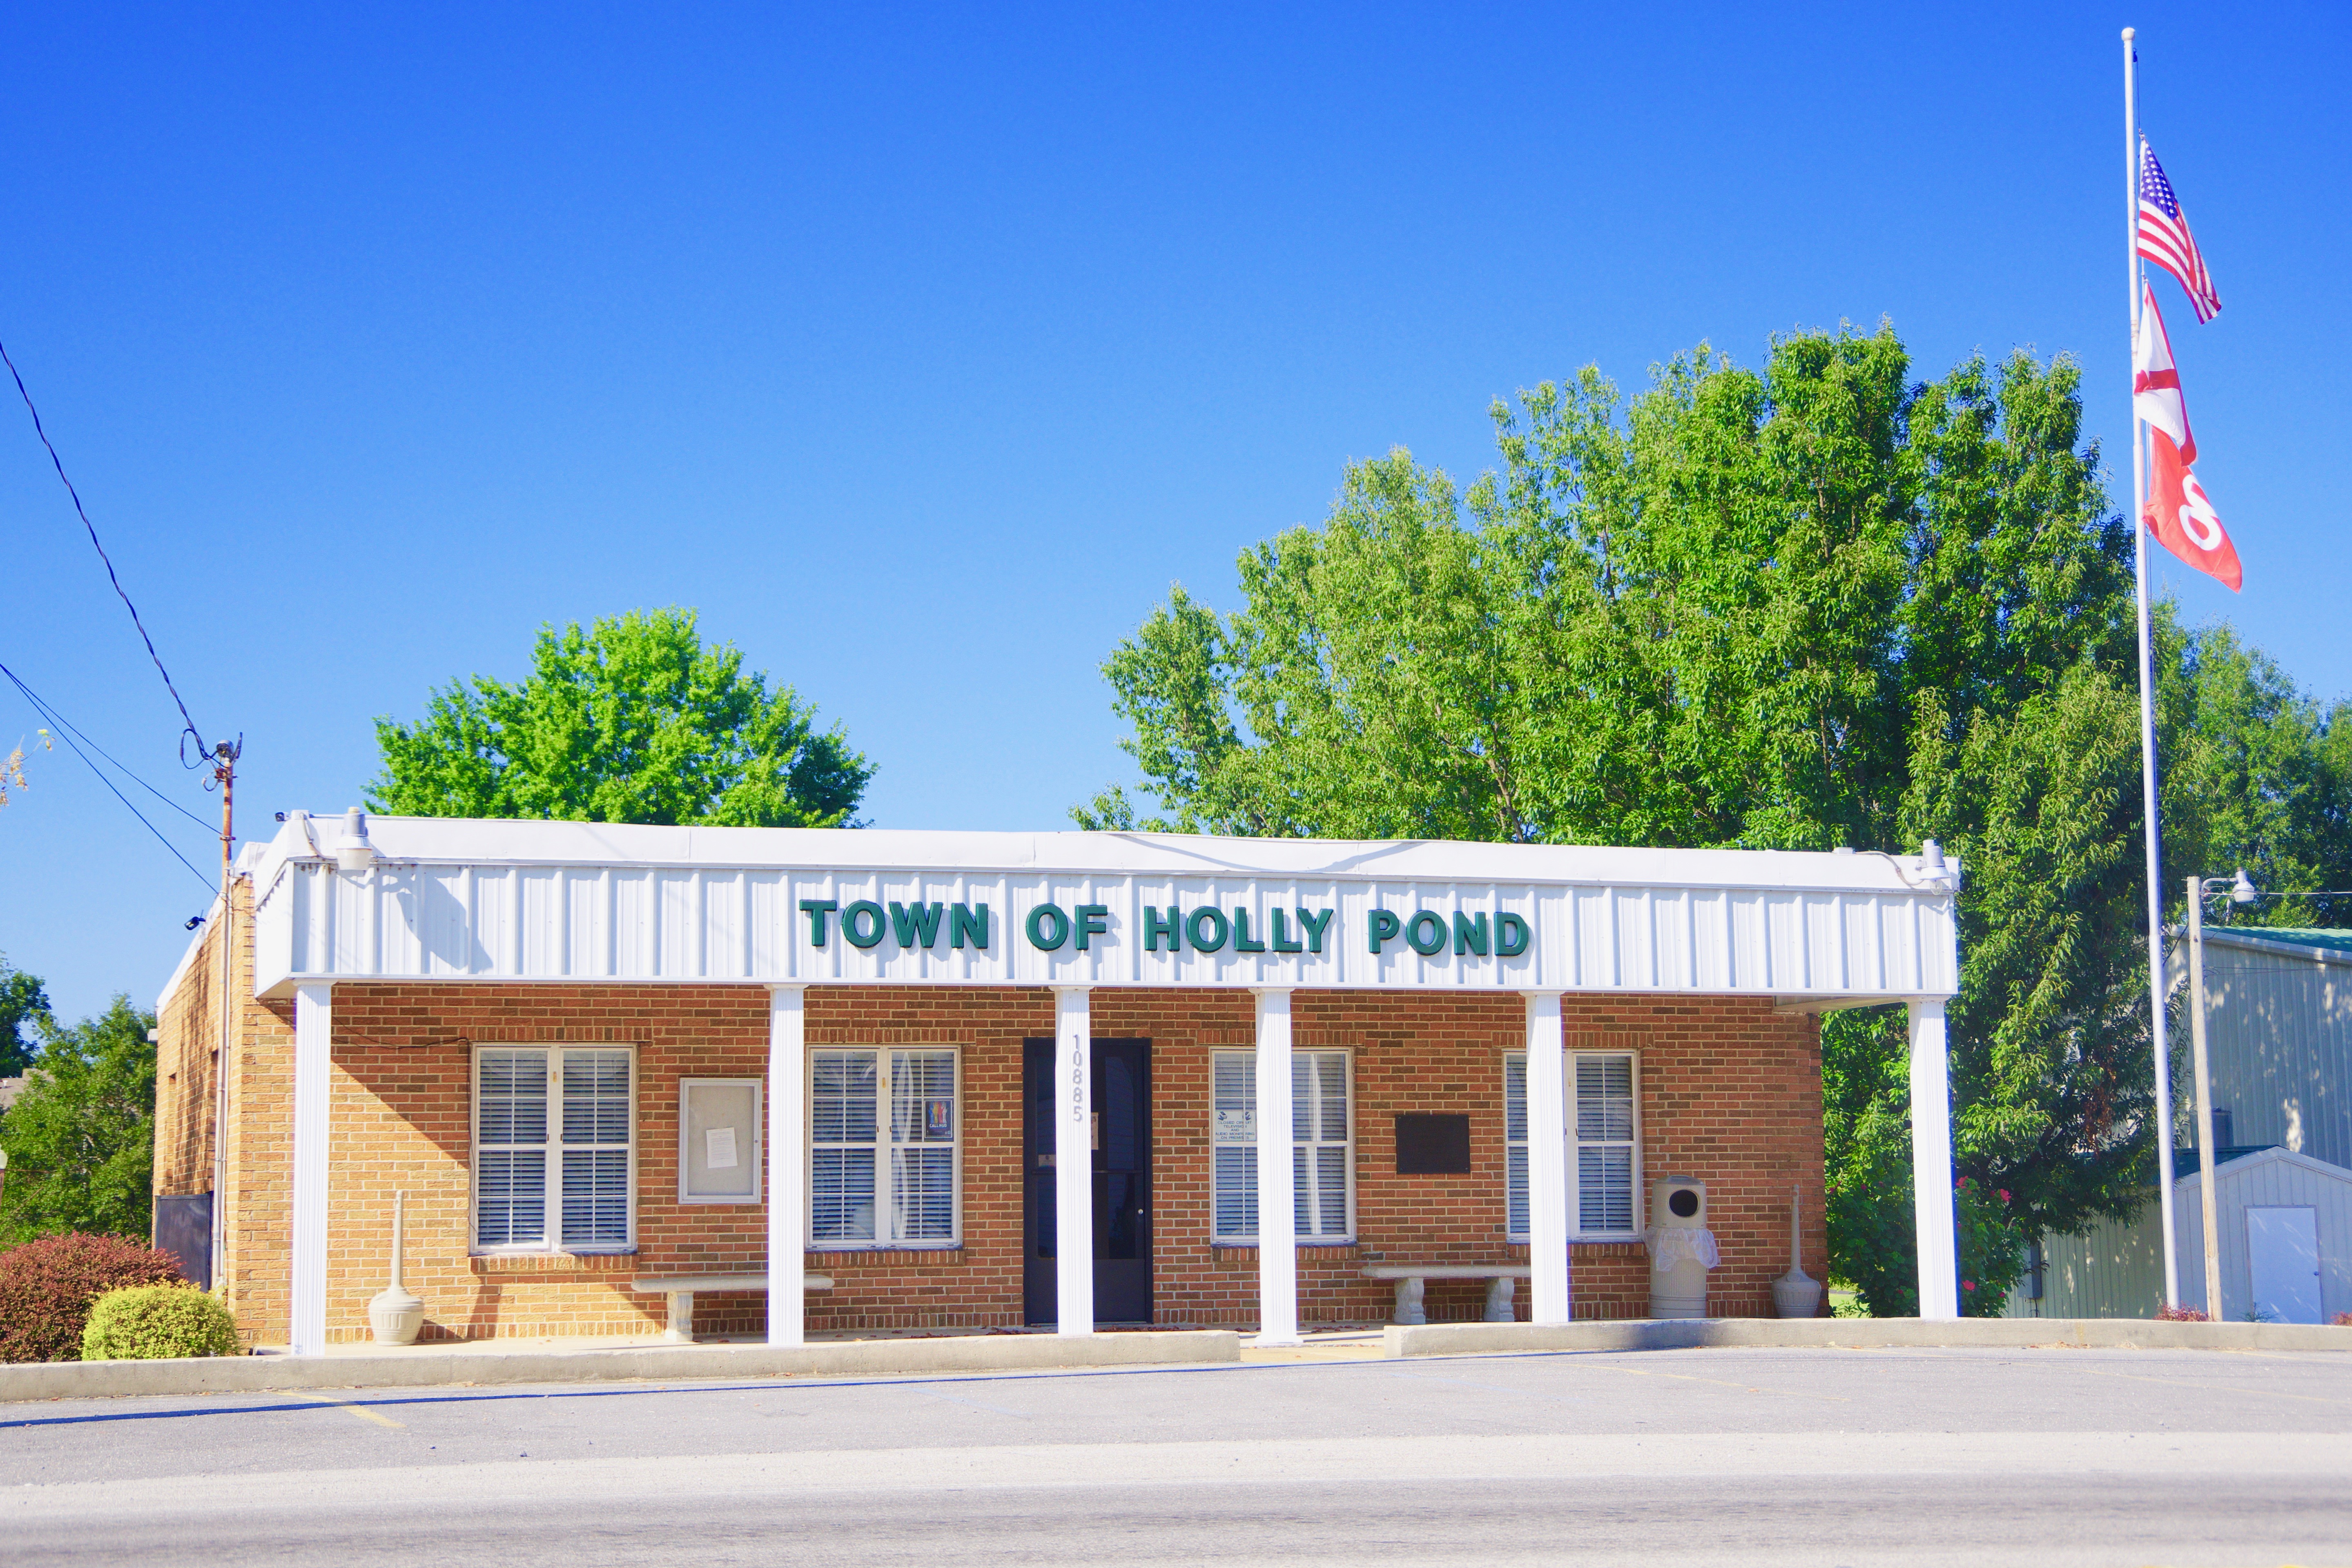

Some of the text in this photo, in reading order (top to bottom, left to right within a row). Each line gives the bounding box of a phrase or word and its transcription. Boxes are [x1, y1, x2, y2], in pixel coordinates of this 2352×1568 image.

[799, 900, 1529, 956] TOWN OF HOLLY POND
[1072, 1034, 1083, 1122] 10885
